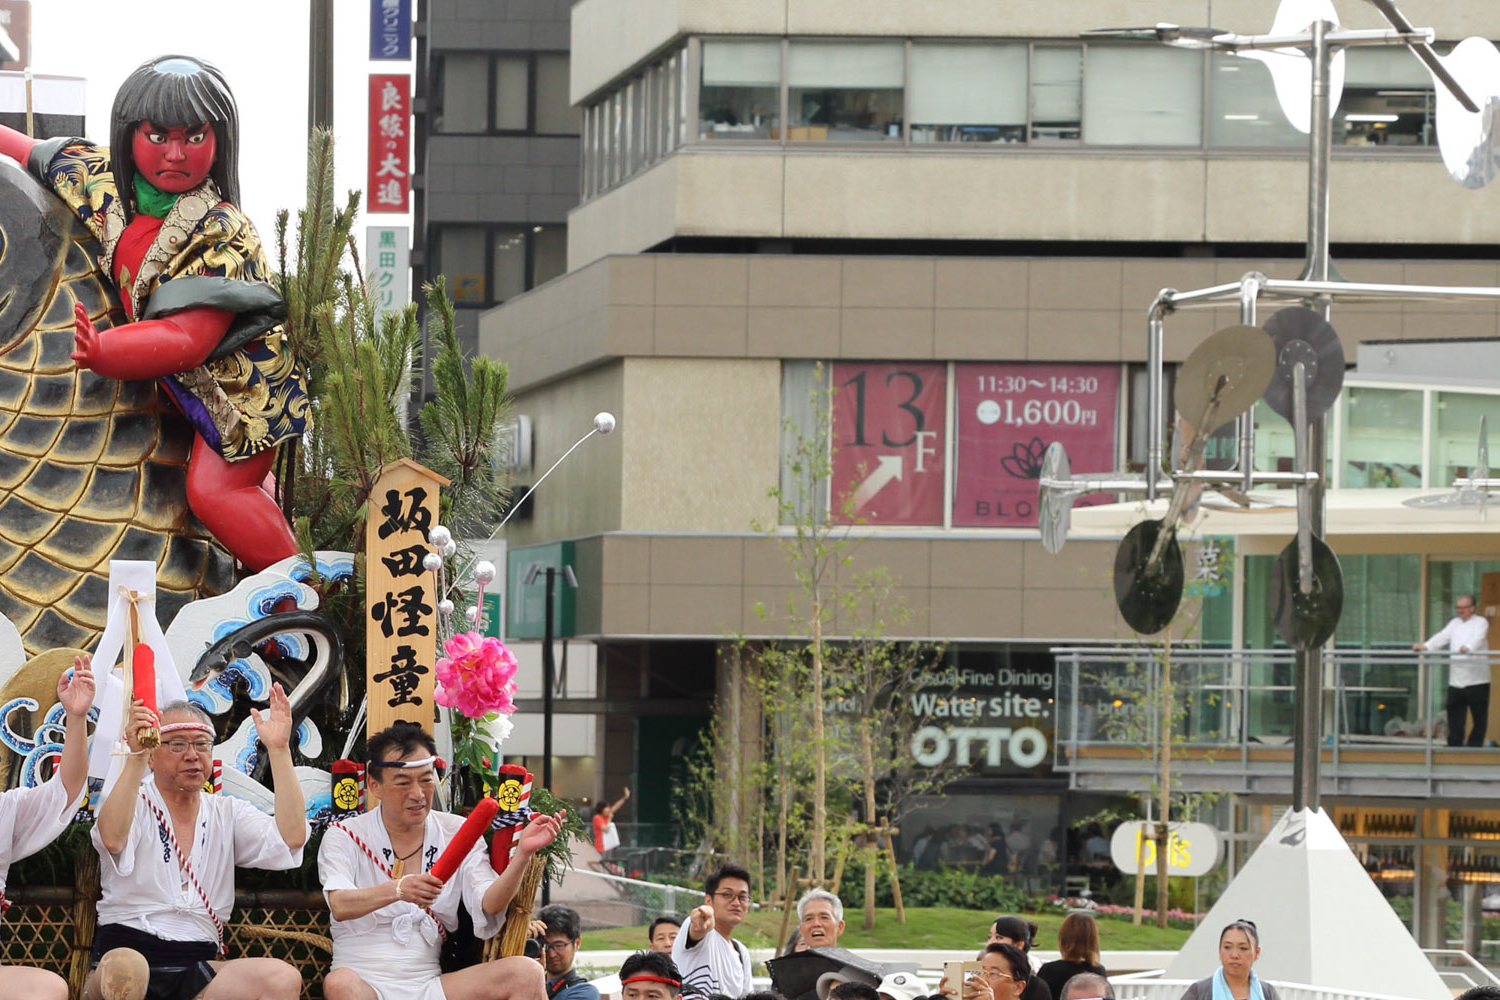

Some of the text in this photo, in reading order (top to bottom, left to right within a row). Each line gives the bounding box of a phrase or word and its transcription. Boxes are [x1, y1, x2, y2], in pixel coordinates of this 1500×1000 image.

[371, 486, 433, 729] 坂田怪童
[961, 668, 995, 687] Fine
[999, 669, 1053, 690] Dining
[911, 693, 983, 719] Water
[910, 726, 1048, 769] OTTO
[1135, 830, 1192, 868] blls
